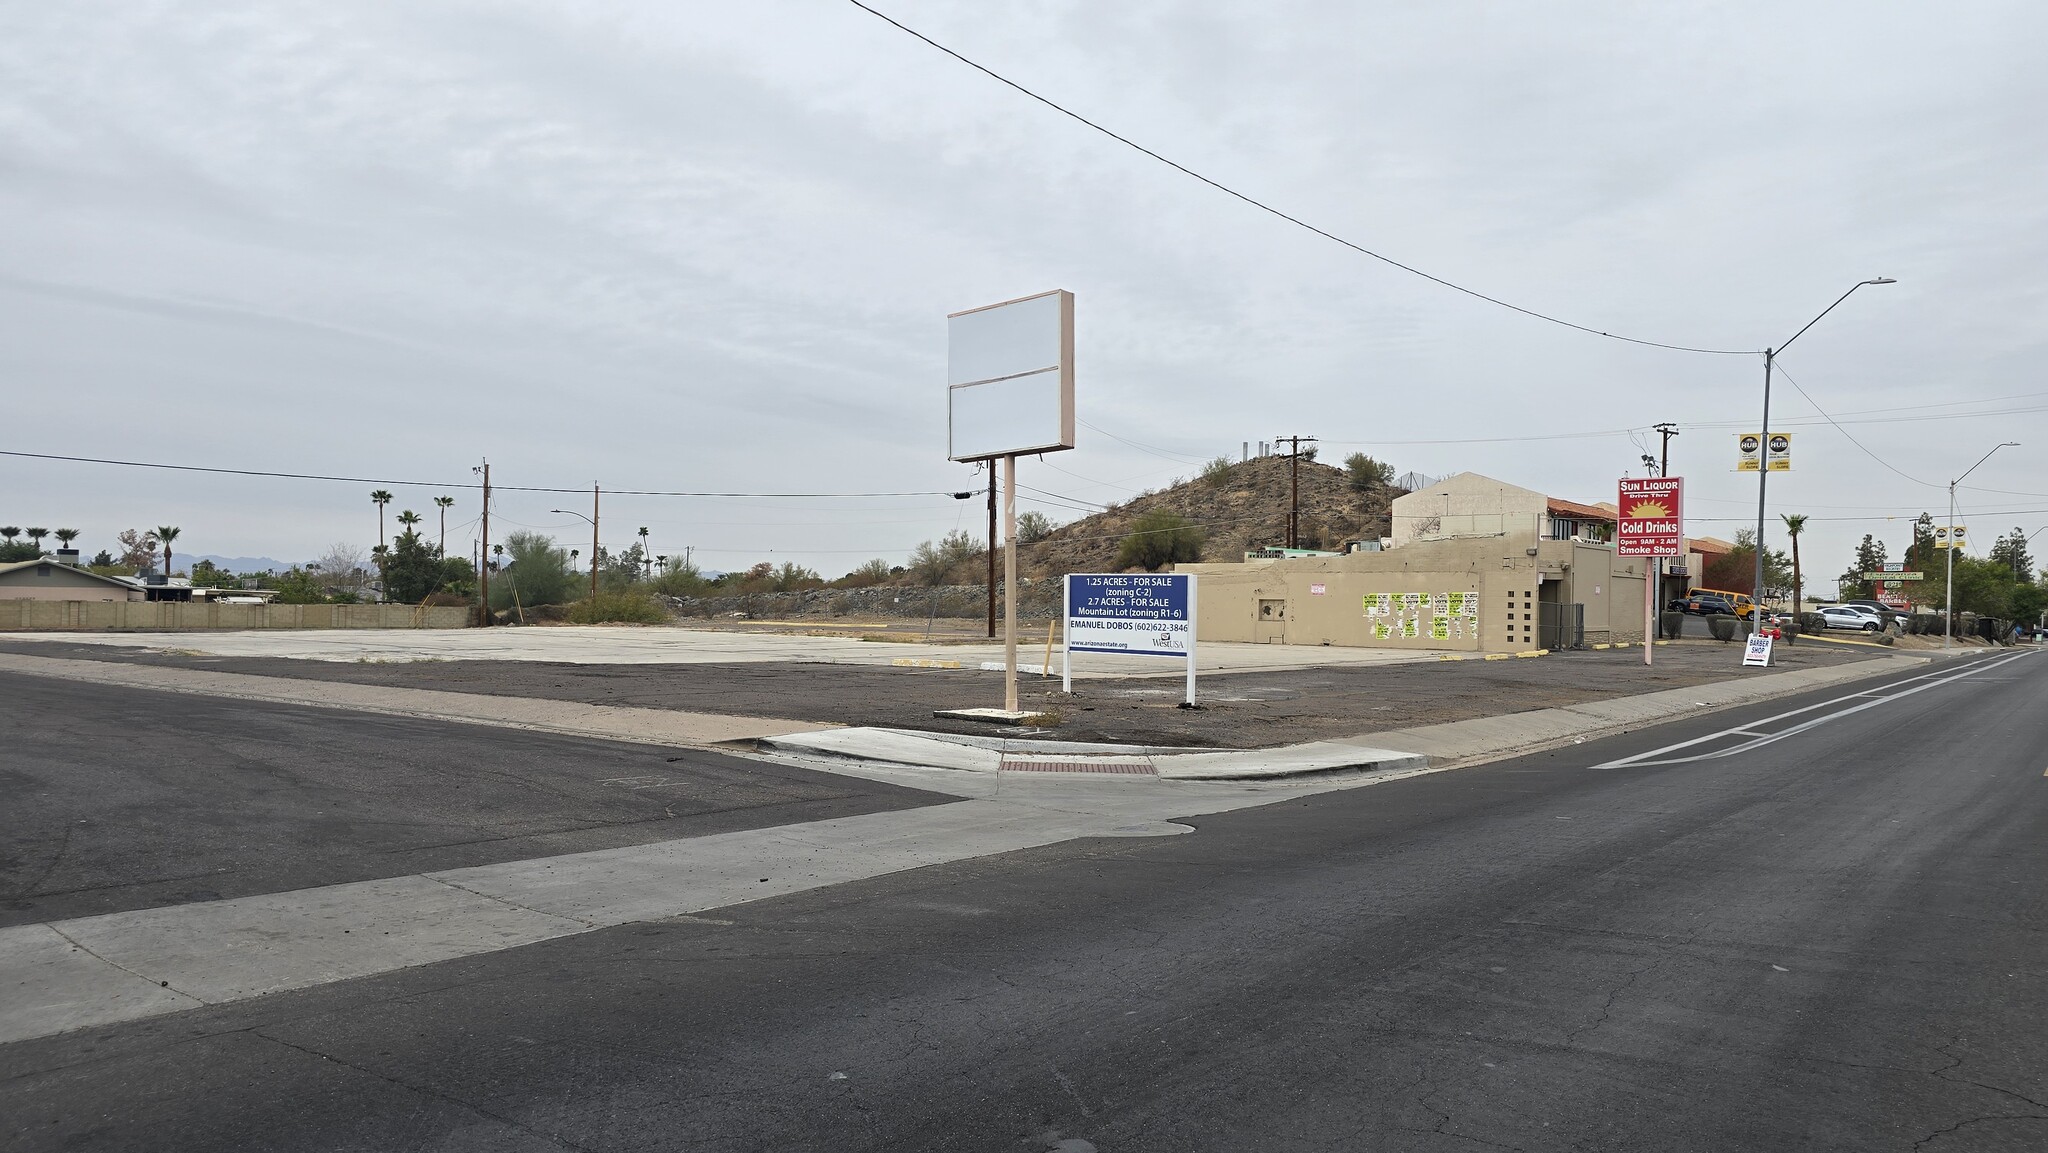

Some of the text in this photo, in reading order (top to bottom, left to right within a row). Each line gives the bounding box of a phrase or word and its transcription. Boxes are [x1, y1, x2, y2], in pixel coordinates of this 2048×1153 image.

[1620, 481, 1678, 491] SUN LIQUOR
[1621, 521, 1677, 534] Cold Drinks
[1620, 546, 1677, 555] Smoke Shop
[1086, 578, 1102, 586] 1.25
[1103, 578, 1128, 586] ACRES
[1134, 578, 1151, 586] FOR
[1151, 578, 1172, 586] SALE
[1105, 588, 1152, 598] (zoning C-2)
[1088, 598, 1099, 606] 2.7
[1100, 598, 1125, 606] ACRES
[1131, 598, 1148, 606] FOR
[1149, 598, 1169, 607] SALE
[1078, 607, 1182, 618] Mountain Lot (zoning R1-6)
[1070, 620, 1188, 632] EMANUEL DOBOS (602)622-3846
[1071, 640, 1128, 649] www.arizonaestate.org
